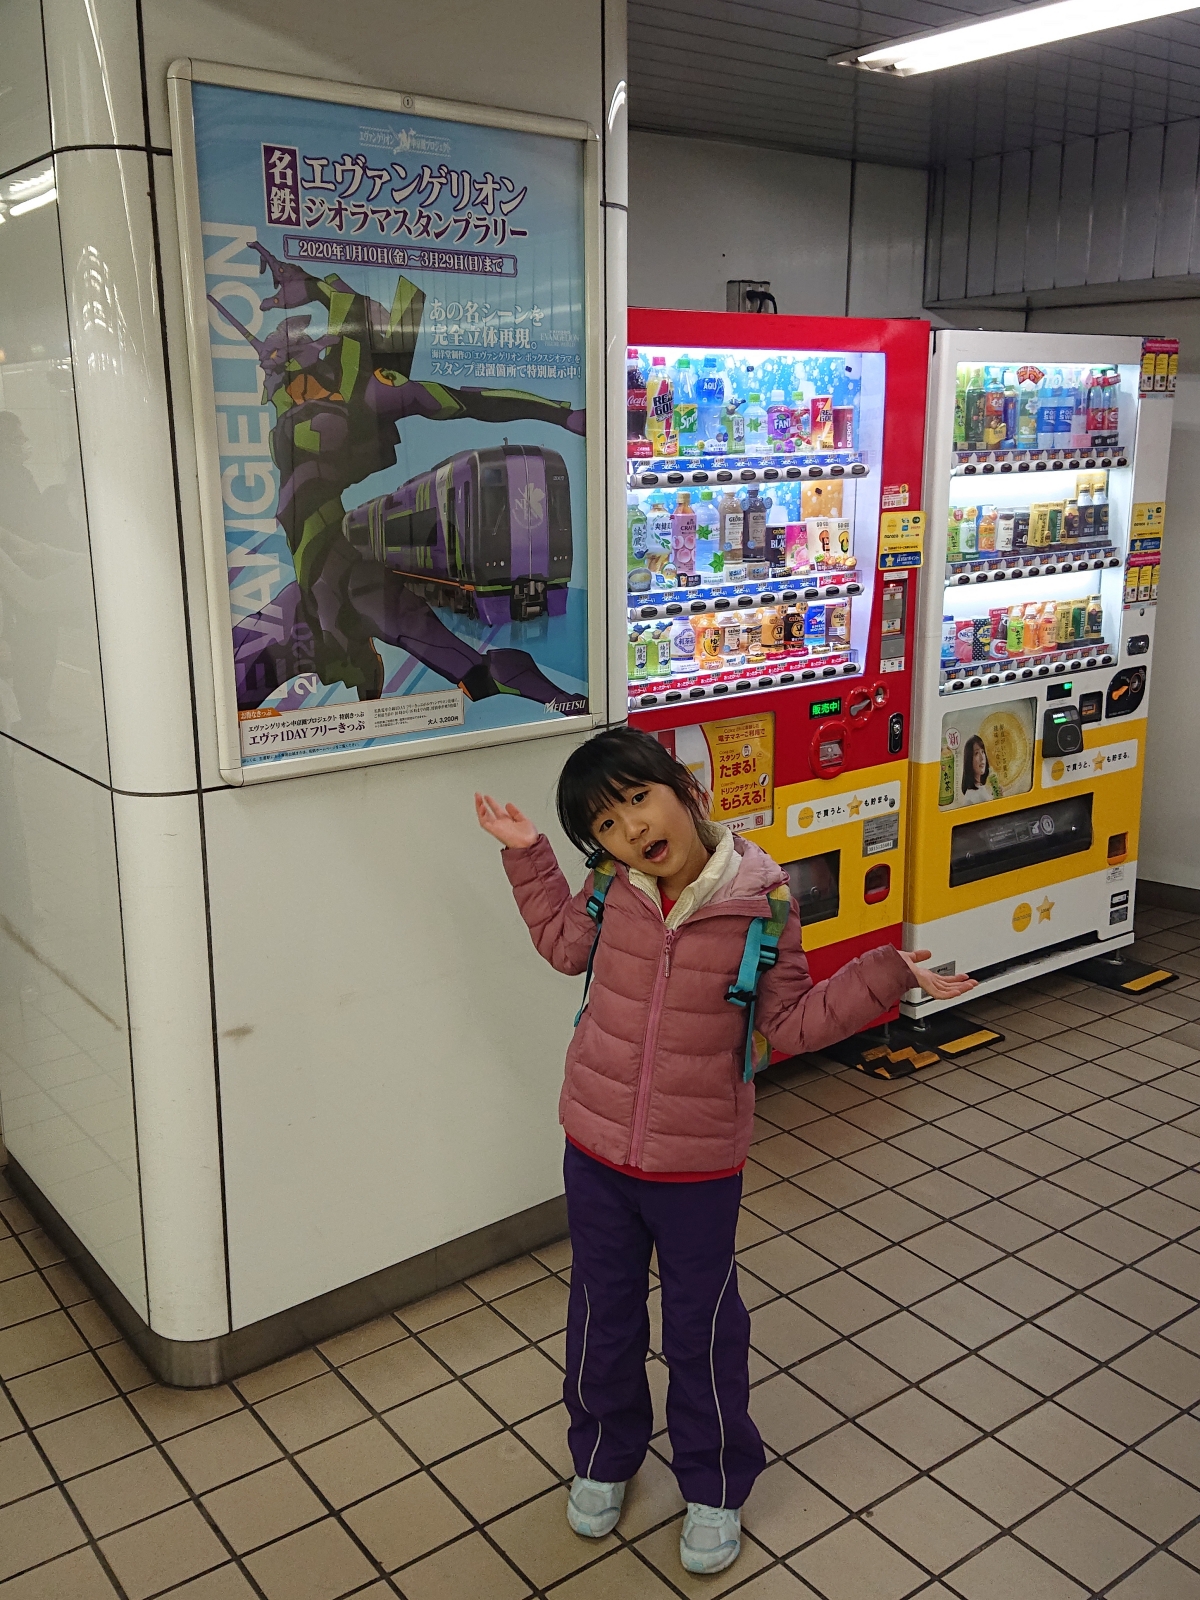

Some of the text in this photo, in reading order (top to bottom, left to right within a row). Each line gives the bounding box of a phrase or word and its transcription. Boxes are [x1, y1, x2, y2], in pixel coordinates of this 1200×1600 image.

[268, 150, 297, 222] 名鉄
[301, 153, 528, 215] エヴァンゲリオン
[303, 198, 529, 247] ジオラマスタンプラリー
[429, 299, 545, 327] あの名シーンを
[430, 324, 538, 350] 完全立体再現。
[543, 697, 586, 714] MEITETSU
[812, 701, 838, 716] 販売中
[949, 731, 959, 747] 新
[719, 753, 740, 763] スタンプ
[719, 758, 756, 779] たまる!
[721, 781, 758, 795] ドリンクチケット
[720, 788, 766, 811] もらえる!
